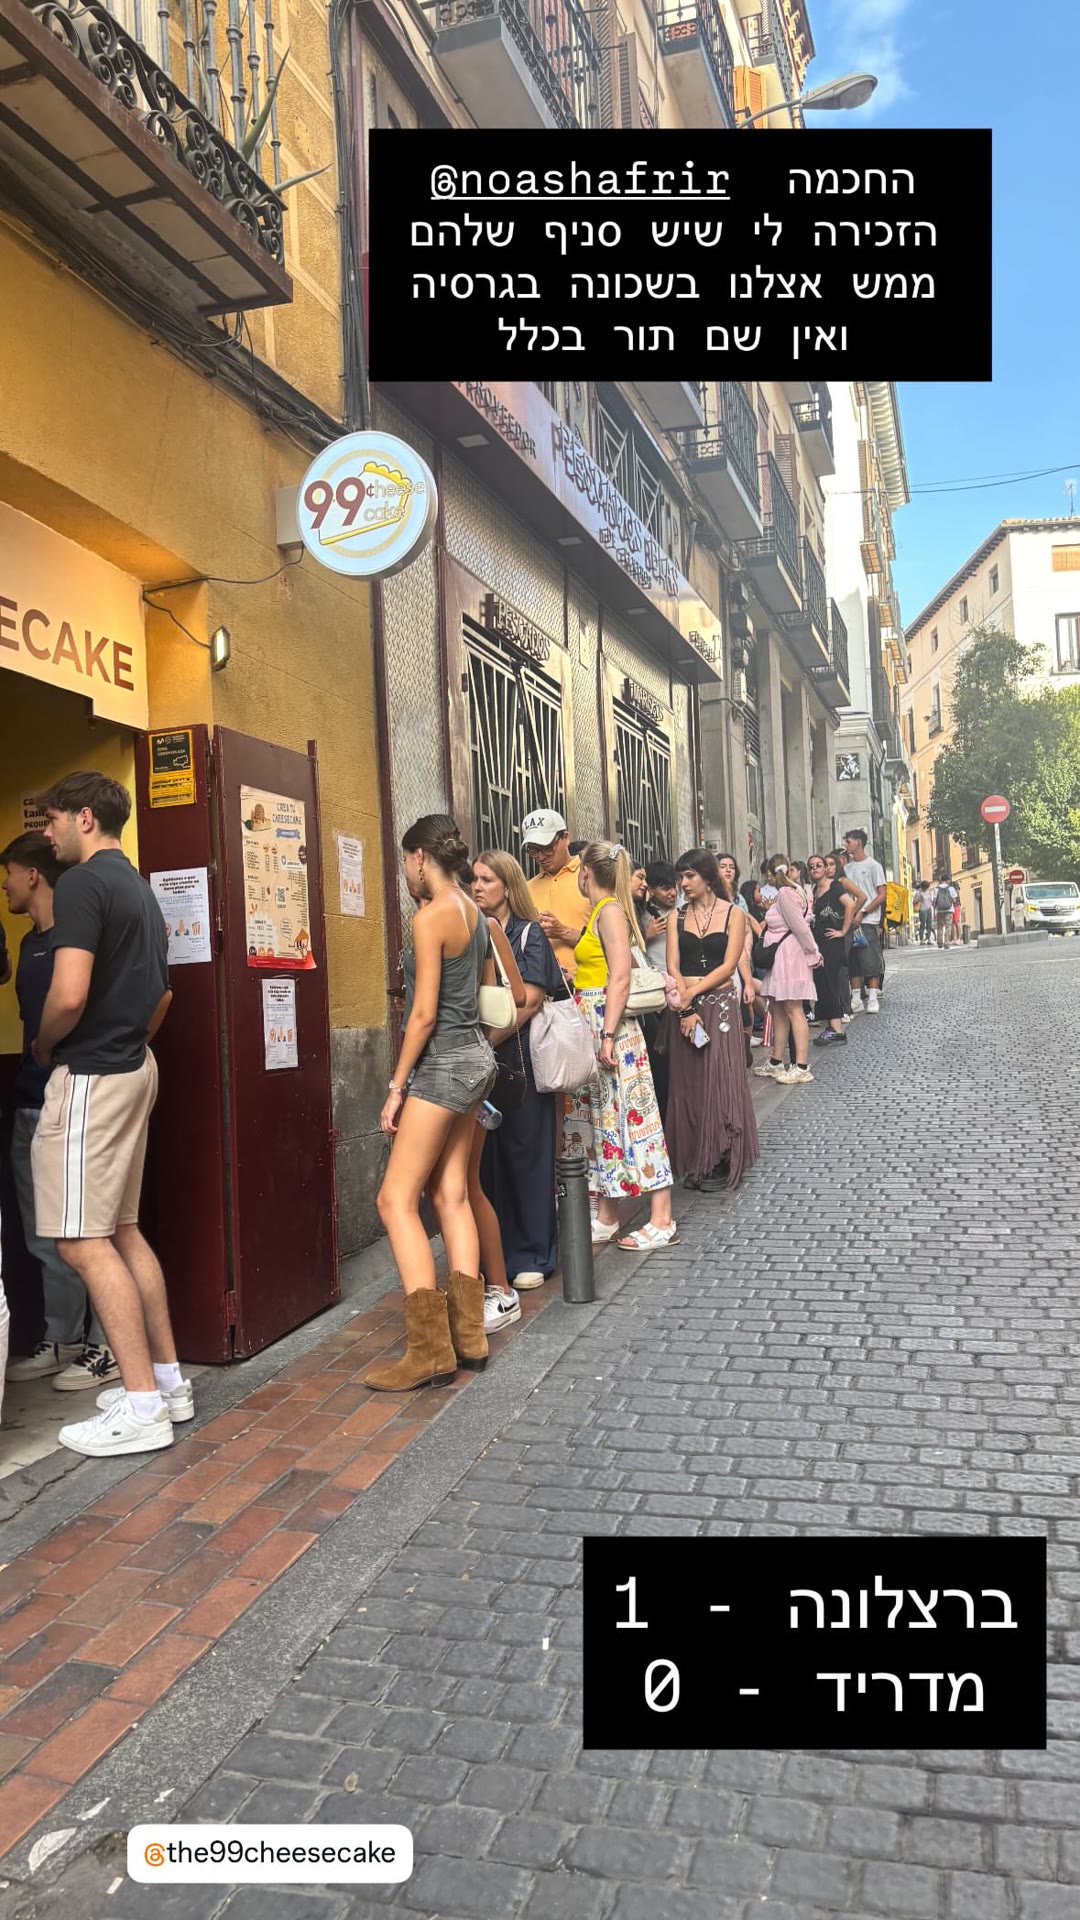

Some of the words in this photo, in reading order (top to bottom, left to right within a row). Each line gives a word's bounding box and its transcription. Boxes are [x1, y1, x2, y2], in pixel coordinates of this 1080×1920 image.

[457, 381, 537, 460] ROVEEDOR
[363, 500, 405, 521] cake
[0, 595, 135, 692] ECAKE
[24, 820, 50, 829] PEQUE
[525, 817, 544, 830] LAX
